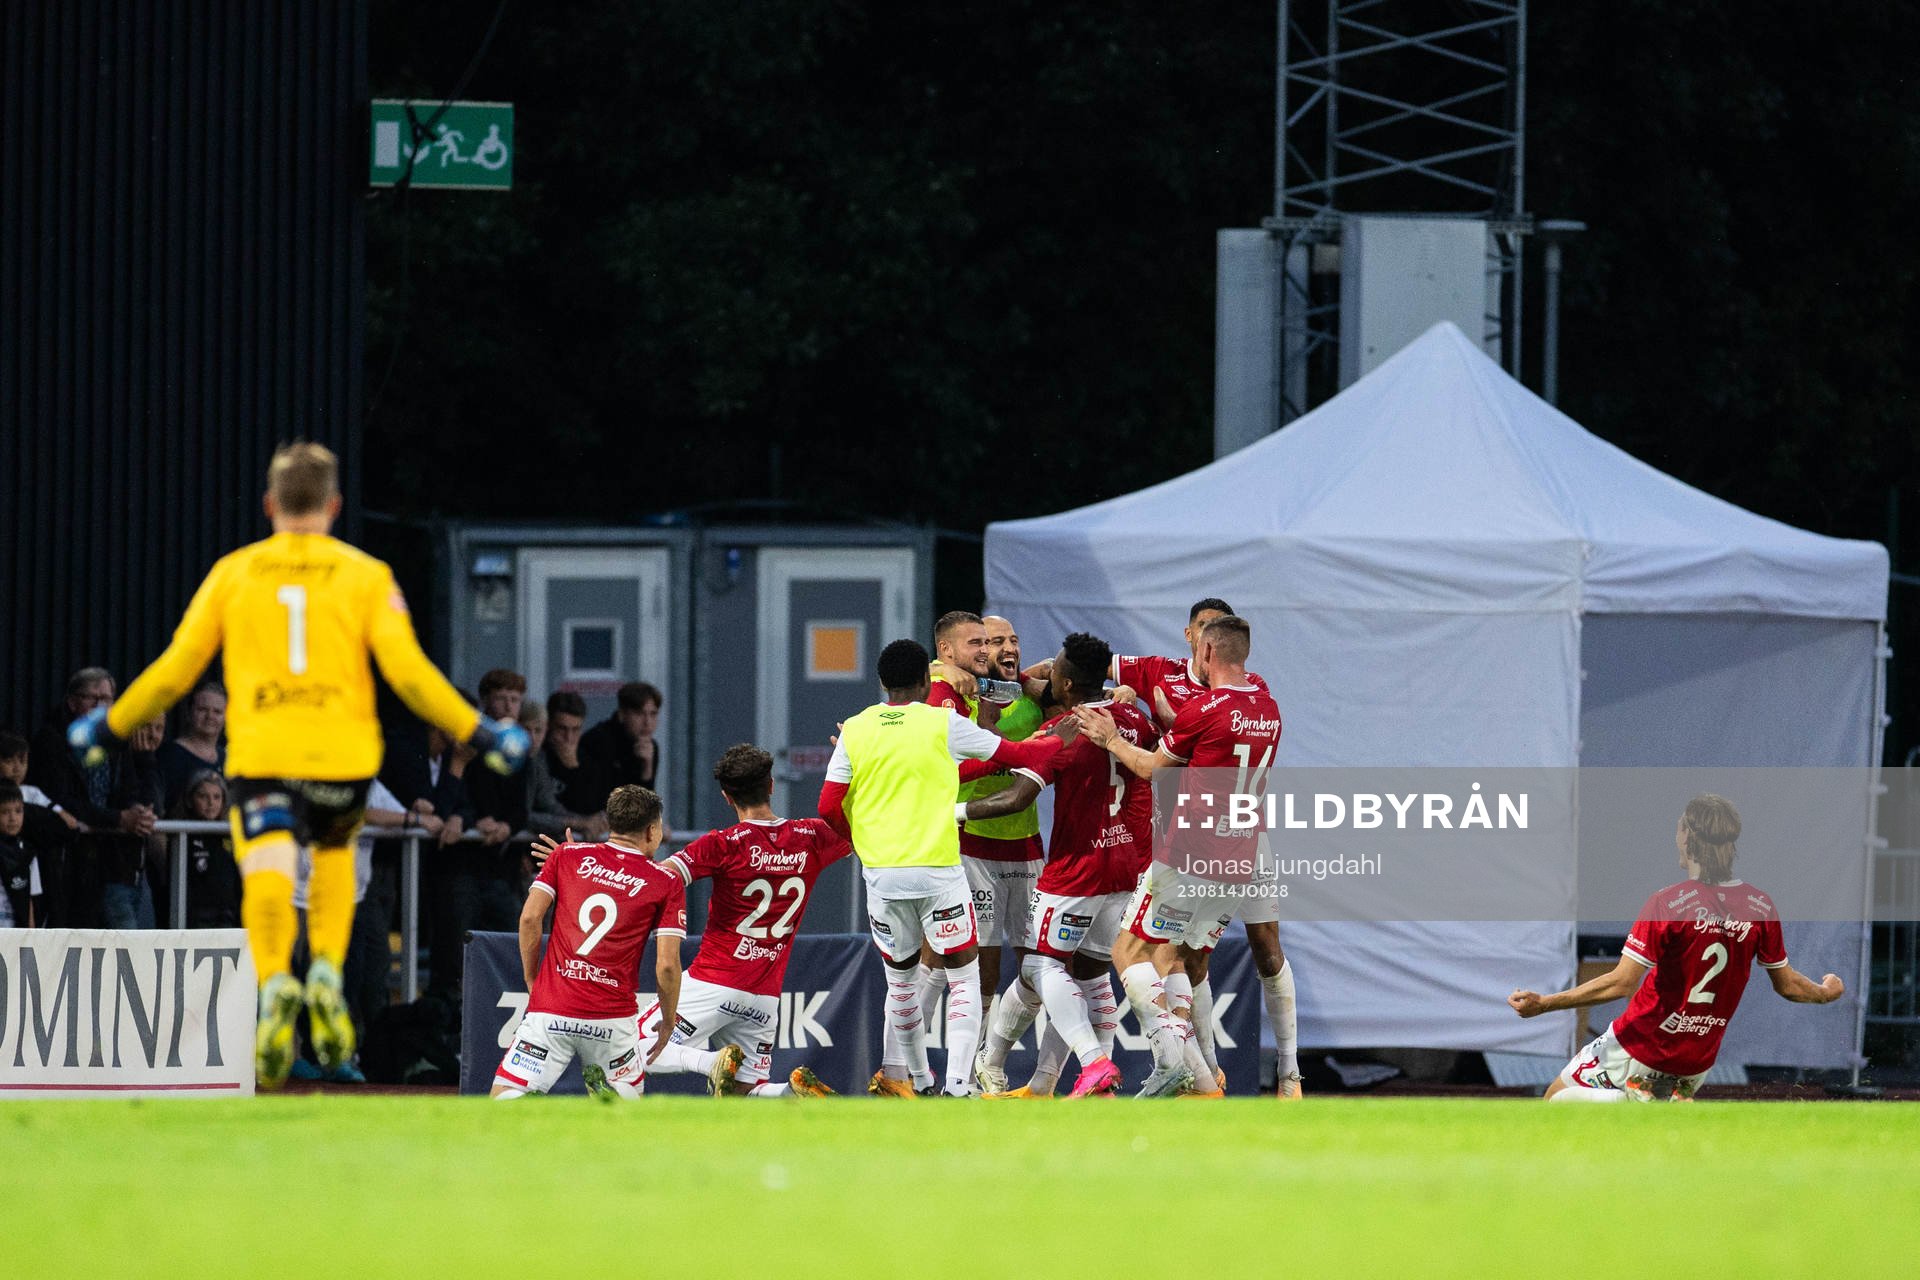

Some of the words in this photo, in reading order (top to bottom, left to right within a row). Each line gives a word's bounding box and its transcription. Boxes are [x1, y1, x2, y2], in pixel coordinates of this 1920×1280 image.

[277, 585, 307, 675] 1
[1230, 709, 1280, 741] Björnberg
[1091, 833, 1133, 848] WELLNESS
[1102, 823, 1126, 838] NORDIC
[749, 845, 808, 874] Björnberg
[576, 856, 648, 897] Björnberg
[735, 877, 806, 939] 22
[577, 893, 618, 956] 9
[941, 923, 959, 933] ICA
[1693, 907, 1754, 943] Björnberg
[556, 964, 618, 987] WELLNESS
[565, 959, 608, 978] NORDIC
[1687, 942, 1728, 1004] 2
[0, 947, 241, 1068] MINIT
[548, 1019, 613, 1039] ALLSON
[1678, 1023, 1713, 1036] Energi
[615, 1066, 630, 1077] ICA
